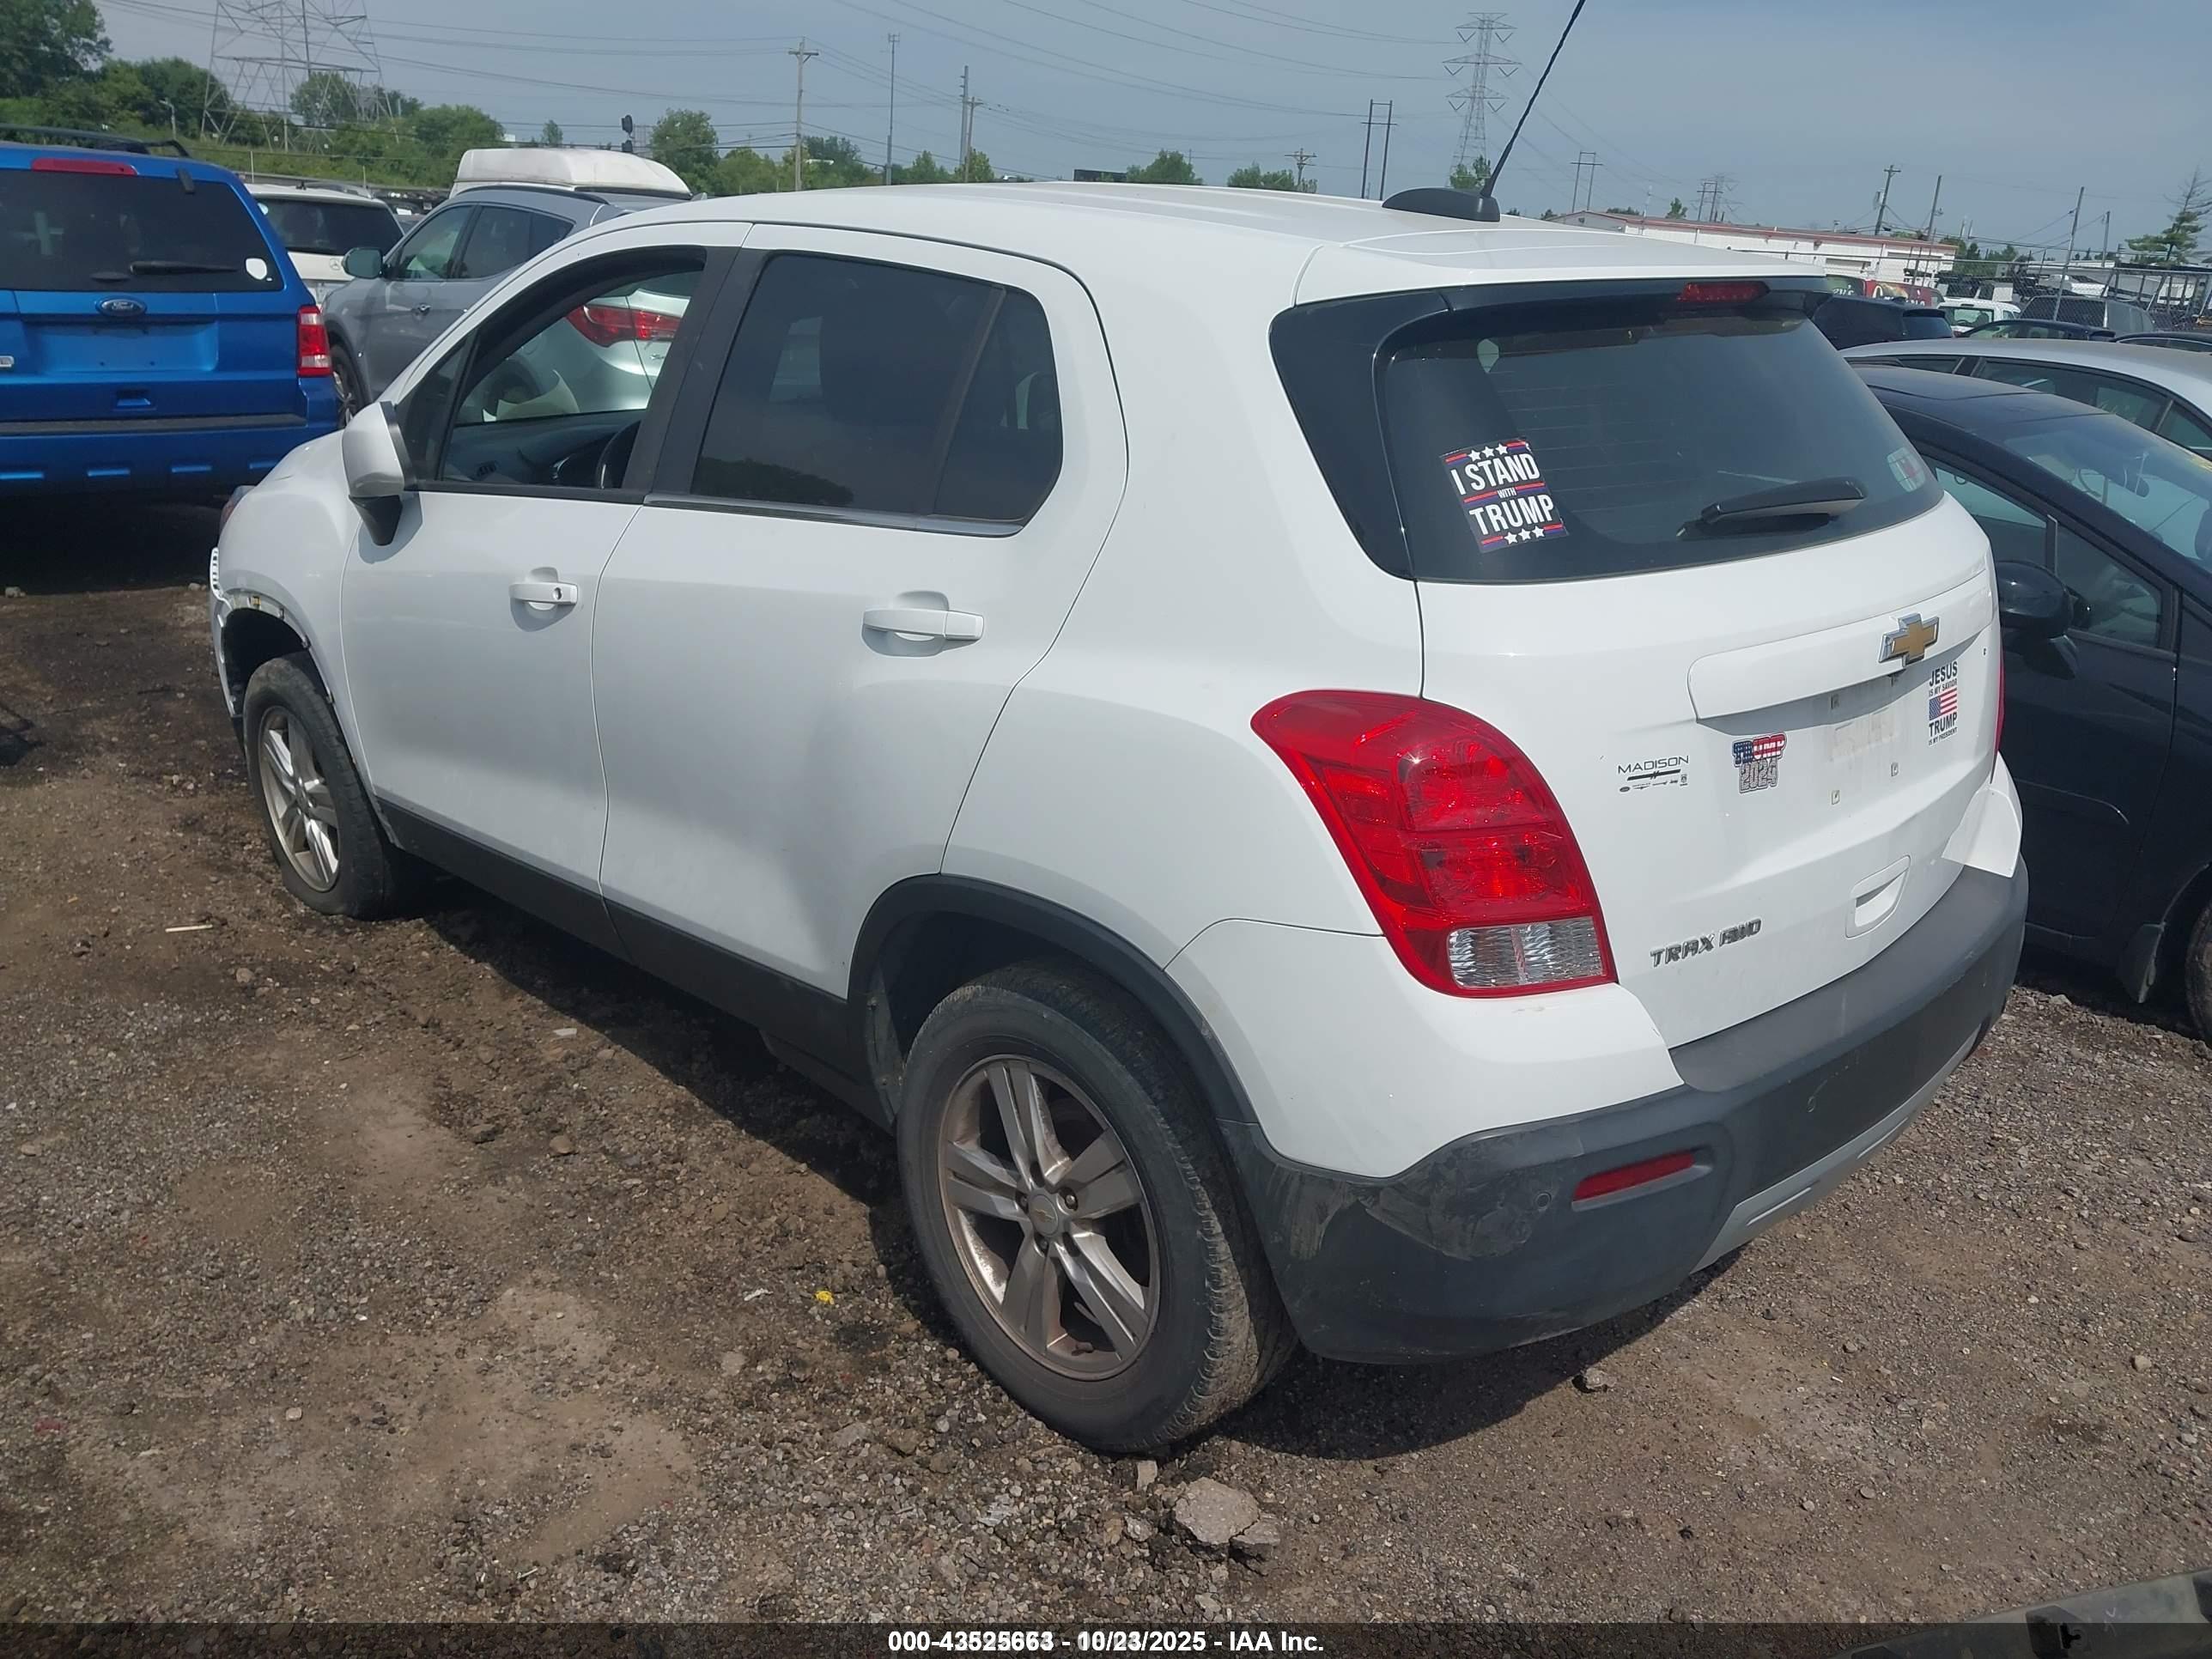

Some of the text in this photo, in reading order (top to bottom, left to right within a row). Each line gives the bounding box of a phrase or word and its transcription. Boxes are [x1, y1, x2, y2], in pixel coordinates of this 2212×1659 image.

[1451, 453, 1540, 495] I STAND
[1497, 487, 1516, 498] WITH
[1469, 495, 1554, 535] TRUMP
[1929, 661, 1958, 686] JESUS
[1929, 712, 1958, 737] TRUMP
[1618, 755, 1689, 775] MADISON
[1733, 733, 1786, 765] TRUMP
[1740, 757, 1778, 791] 2024
[1650, 933, 1716, 967] TRAX
